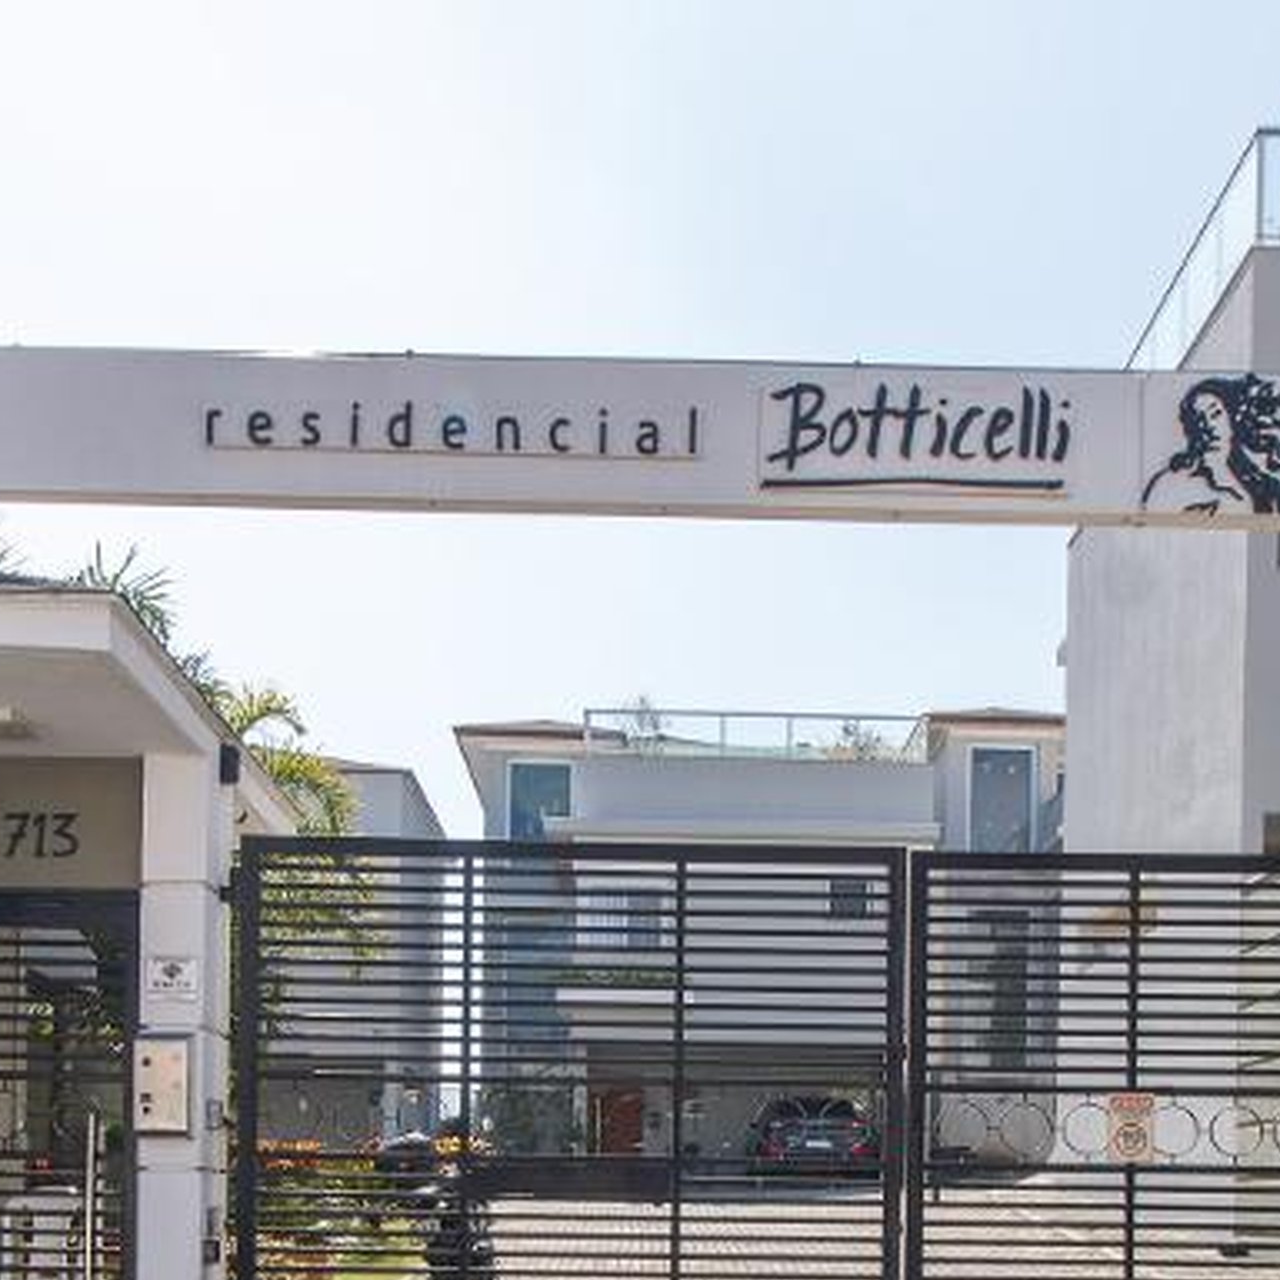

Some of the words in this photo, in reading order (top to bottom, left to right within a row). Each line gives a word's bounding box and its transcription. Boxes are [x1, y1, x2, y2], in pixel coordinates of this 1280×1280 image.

[204, 401, 698, 455] residencial
[766, 382, 1070, 472] Botticelli
[3, 811, 81, 858] 713
